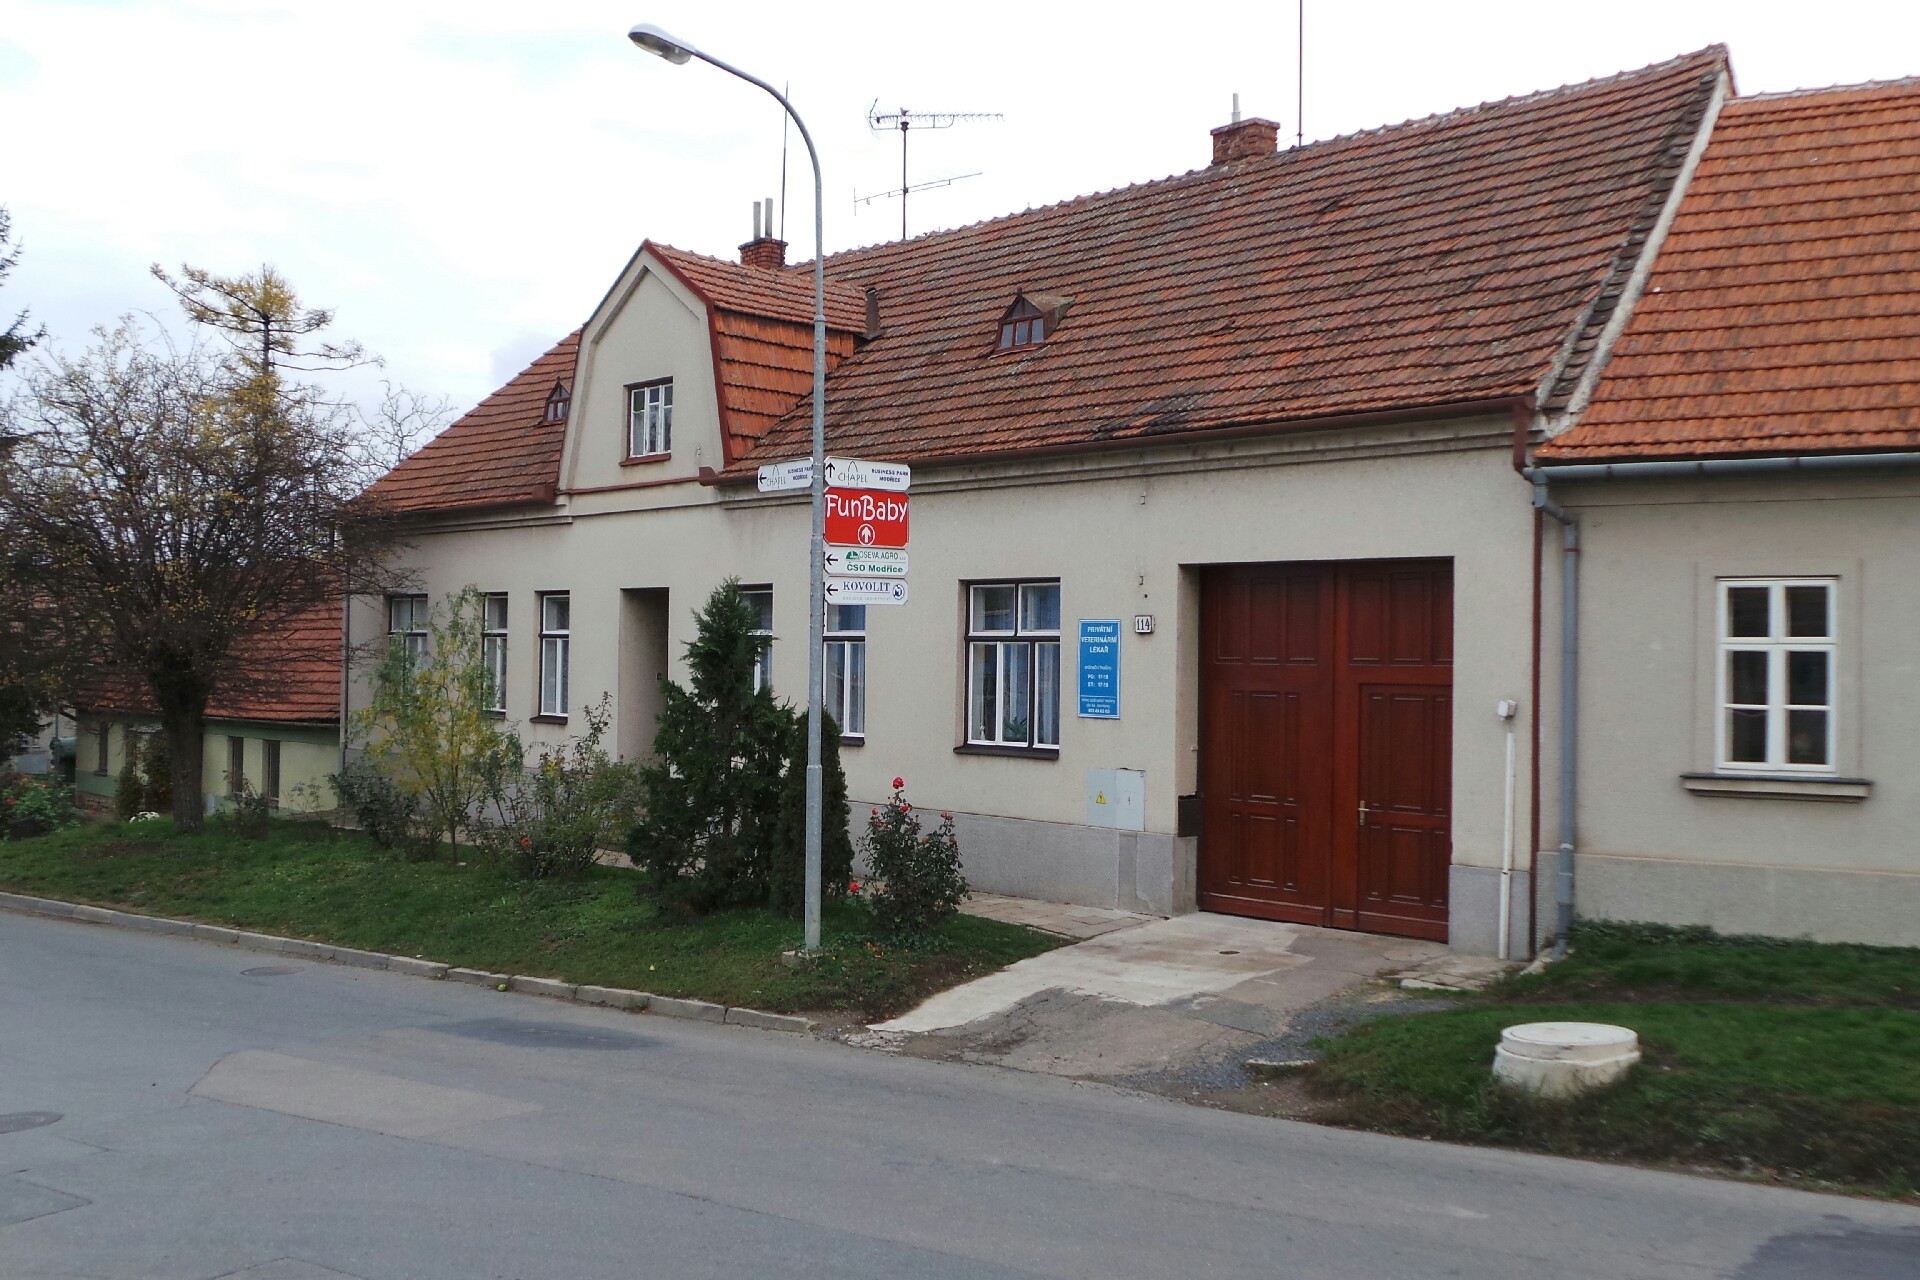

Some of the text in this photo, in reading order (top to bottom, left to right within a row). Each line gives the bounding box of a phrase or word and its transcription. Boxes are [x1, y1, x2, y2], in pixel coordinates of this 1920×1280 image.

[838, 472, 868, 482] CHAPEL
[824, 494, 908, 522] FunBaby
[847, 562, 903, 572] ČSO Modřice
[843, 581, 890, 592] KOVOLIT
[1137, 618, 1150, 631] 114
[1081, 635, 1117, 643] VETERINÁRNÍ
